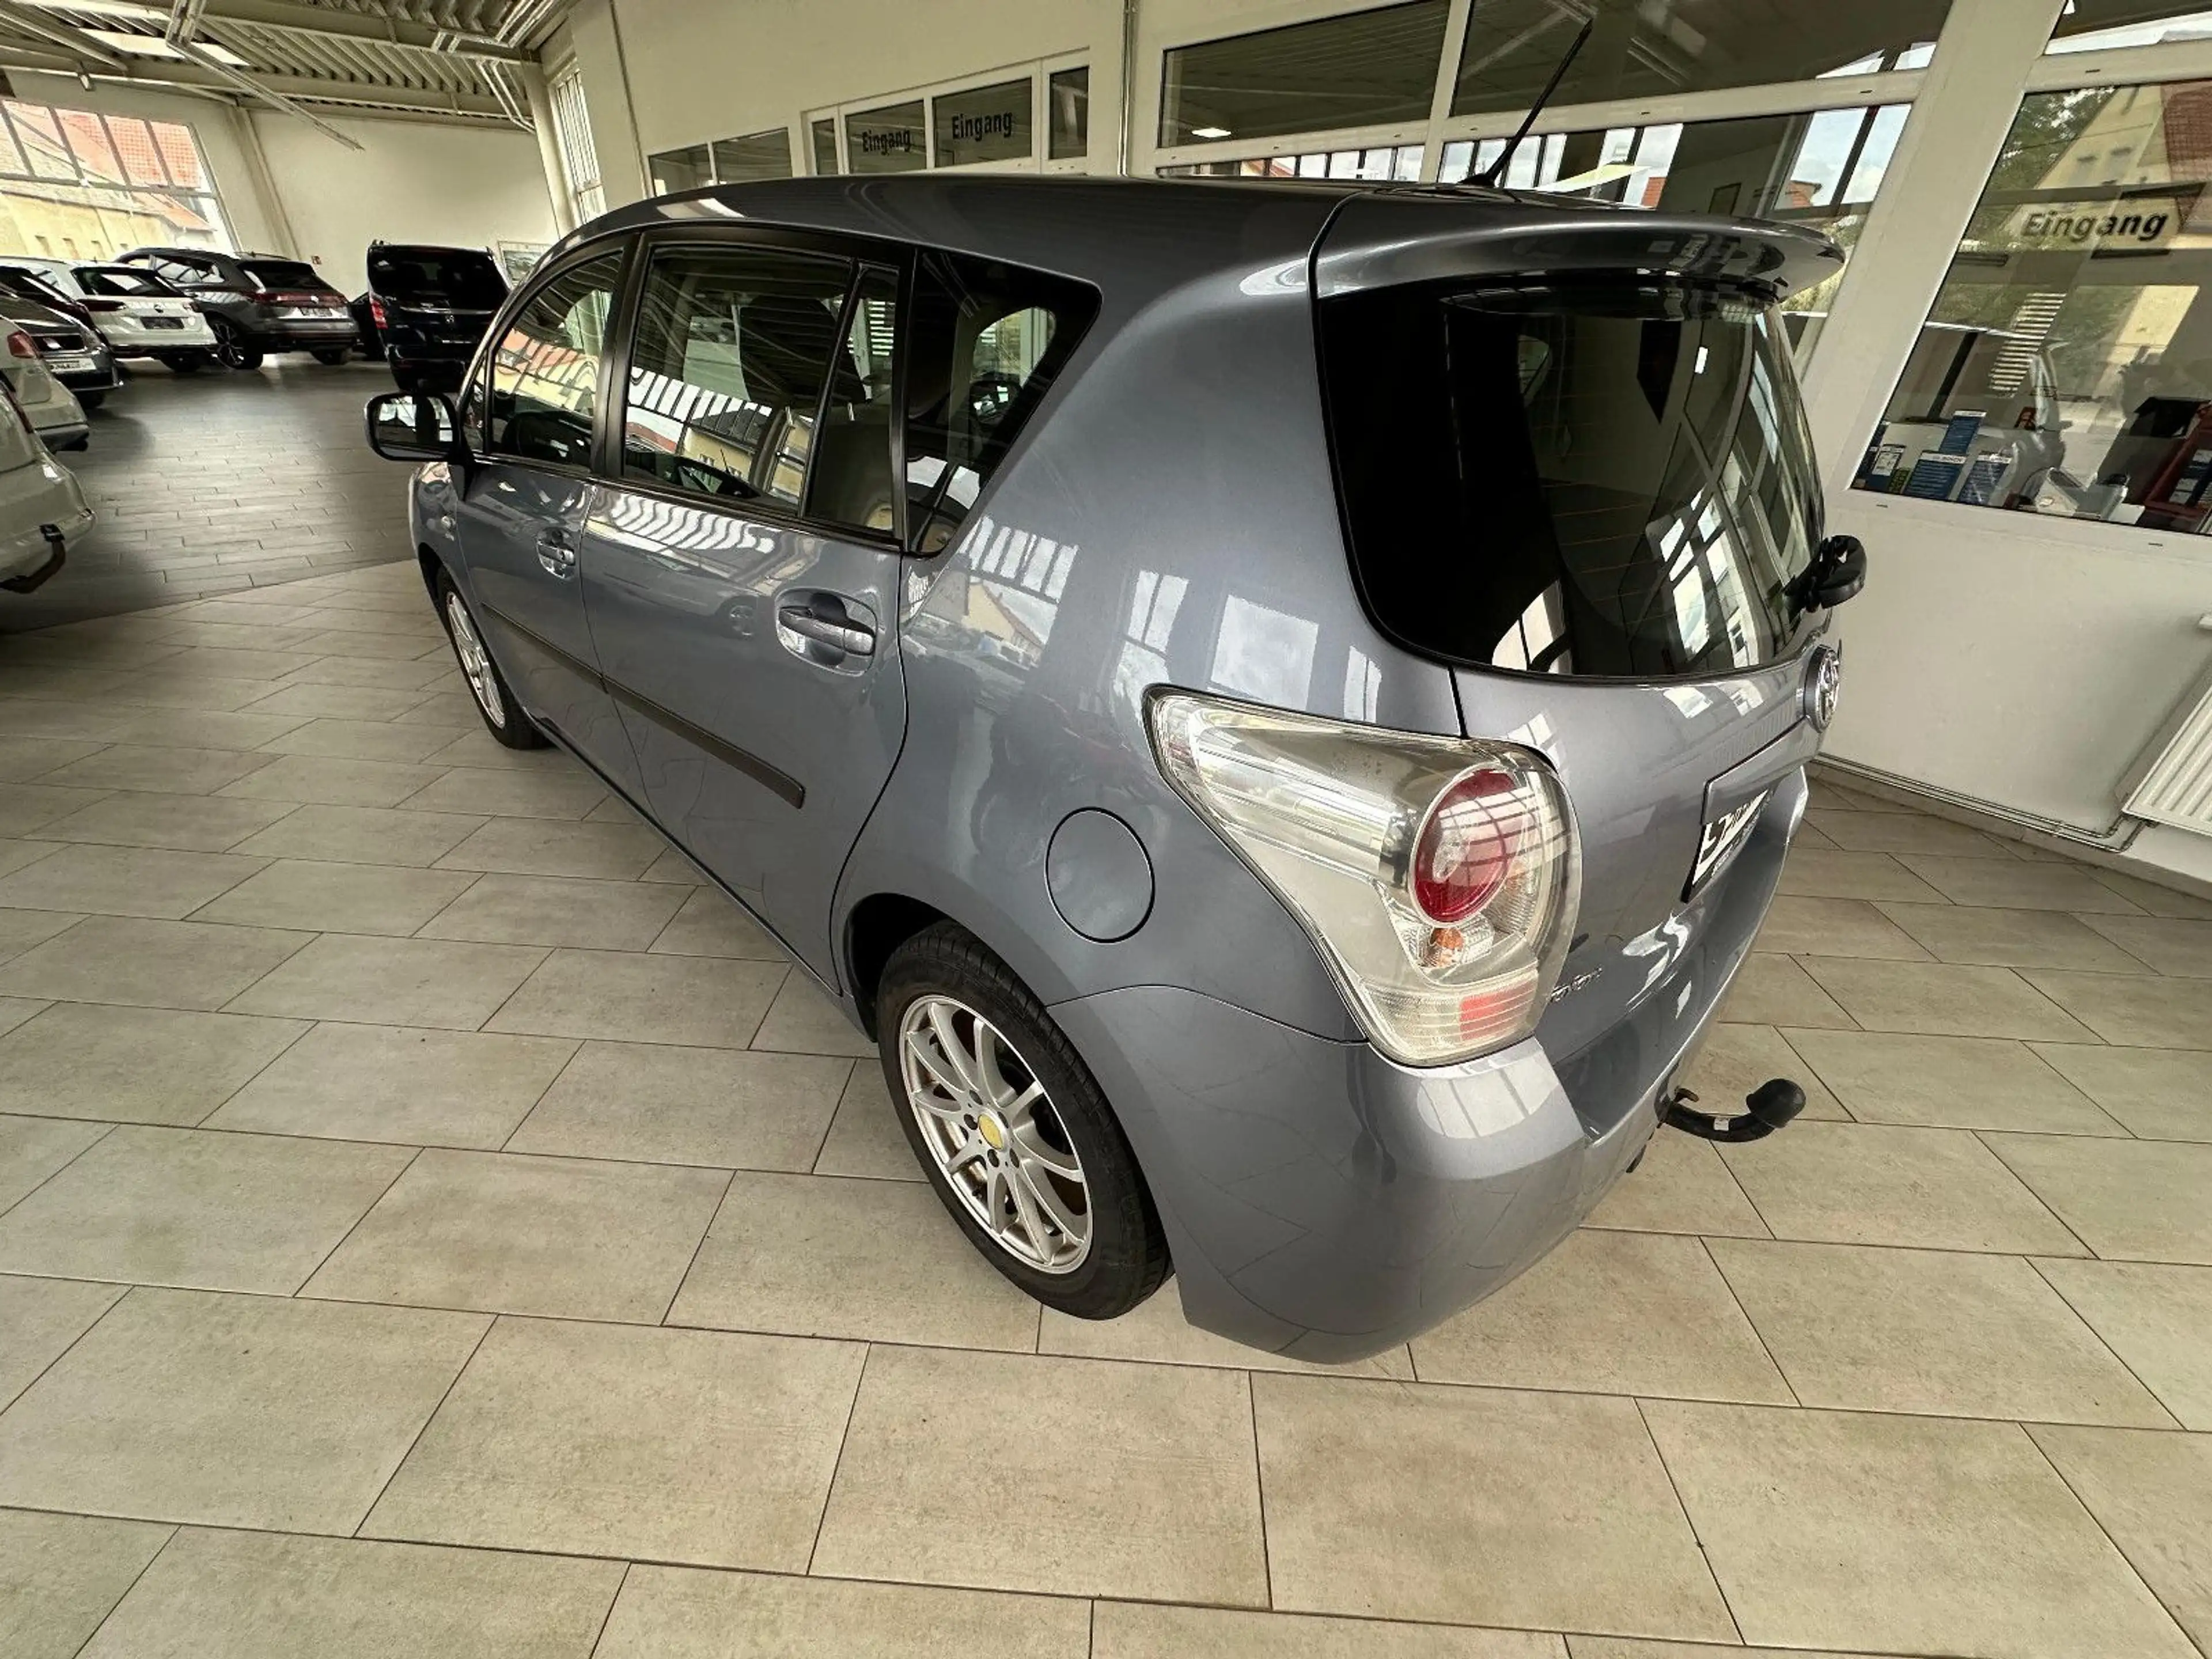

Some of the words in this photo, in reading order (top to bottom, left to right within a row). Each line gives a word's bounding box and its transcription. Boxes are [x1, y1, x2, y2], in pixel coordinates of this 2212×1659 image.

[952, 112, 1013, 142] Eingang
[862, 130, 911, 155] Eingang
[2021, 210, 2168, 242] Eingang
